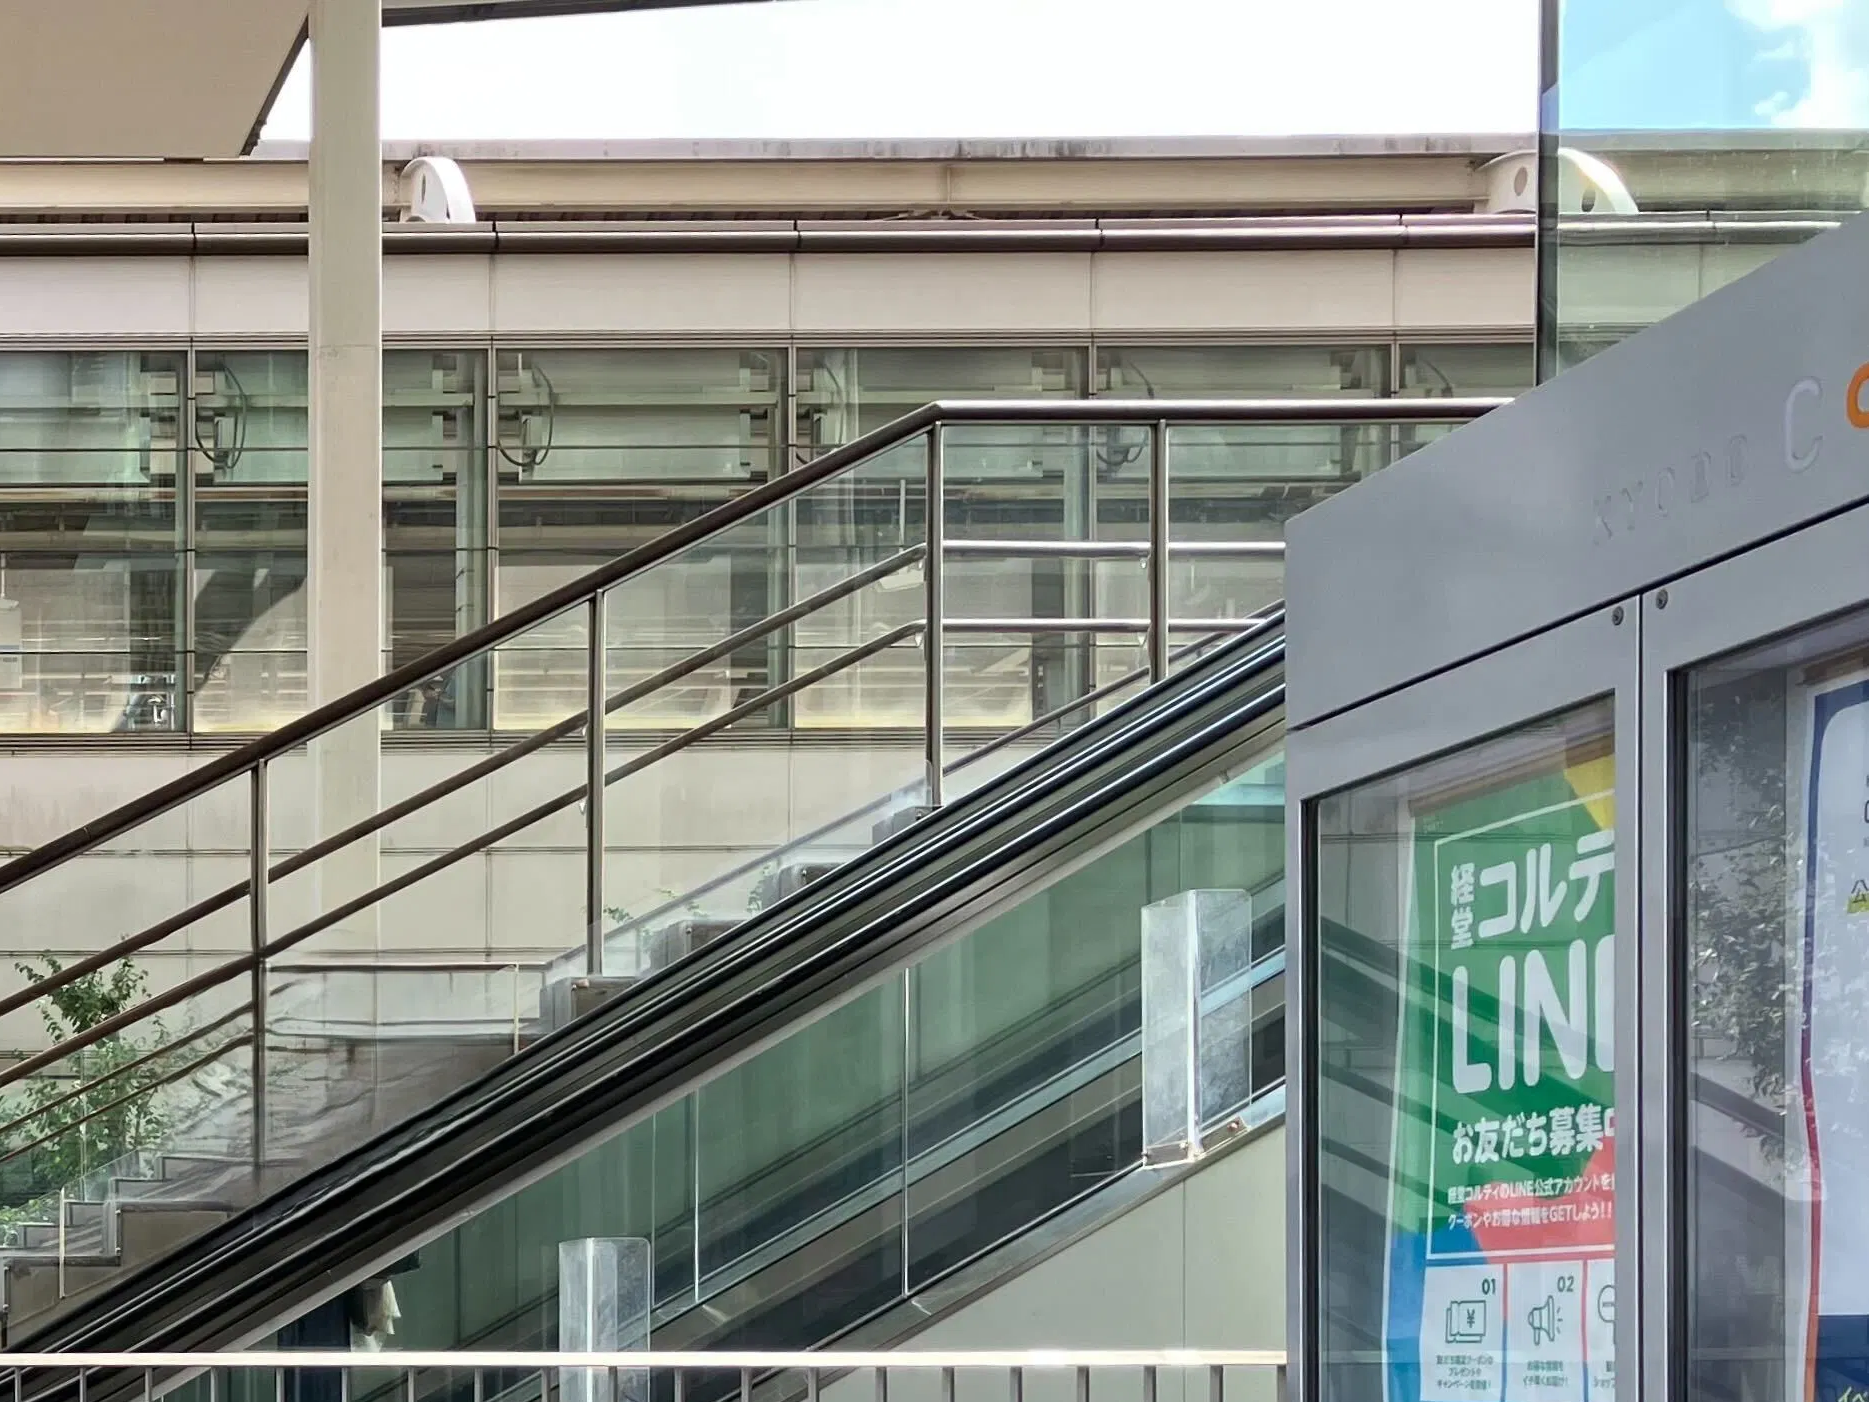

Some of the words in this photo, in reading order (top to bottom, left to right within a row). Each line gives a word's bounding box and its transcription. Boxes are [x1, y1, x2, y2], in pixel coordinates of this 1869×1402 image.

[1447, 1172, 1615, 1204] 経堂コルティのLINE公式アカウントを
[1481, 1278, 1496, 1295] 01
[1557, 1276, 1574, 1293] 02
